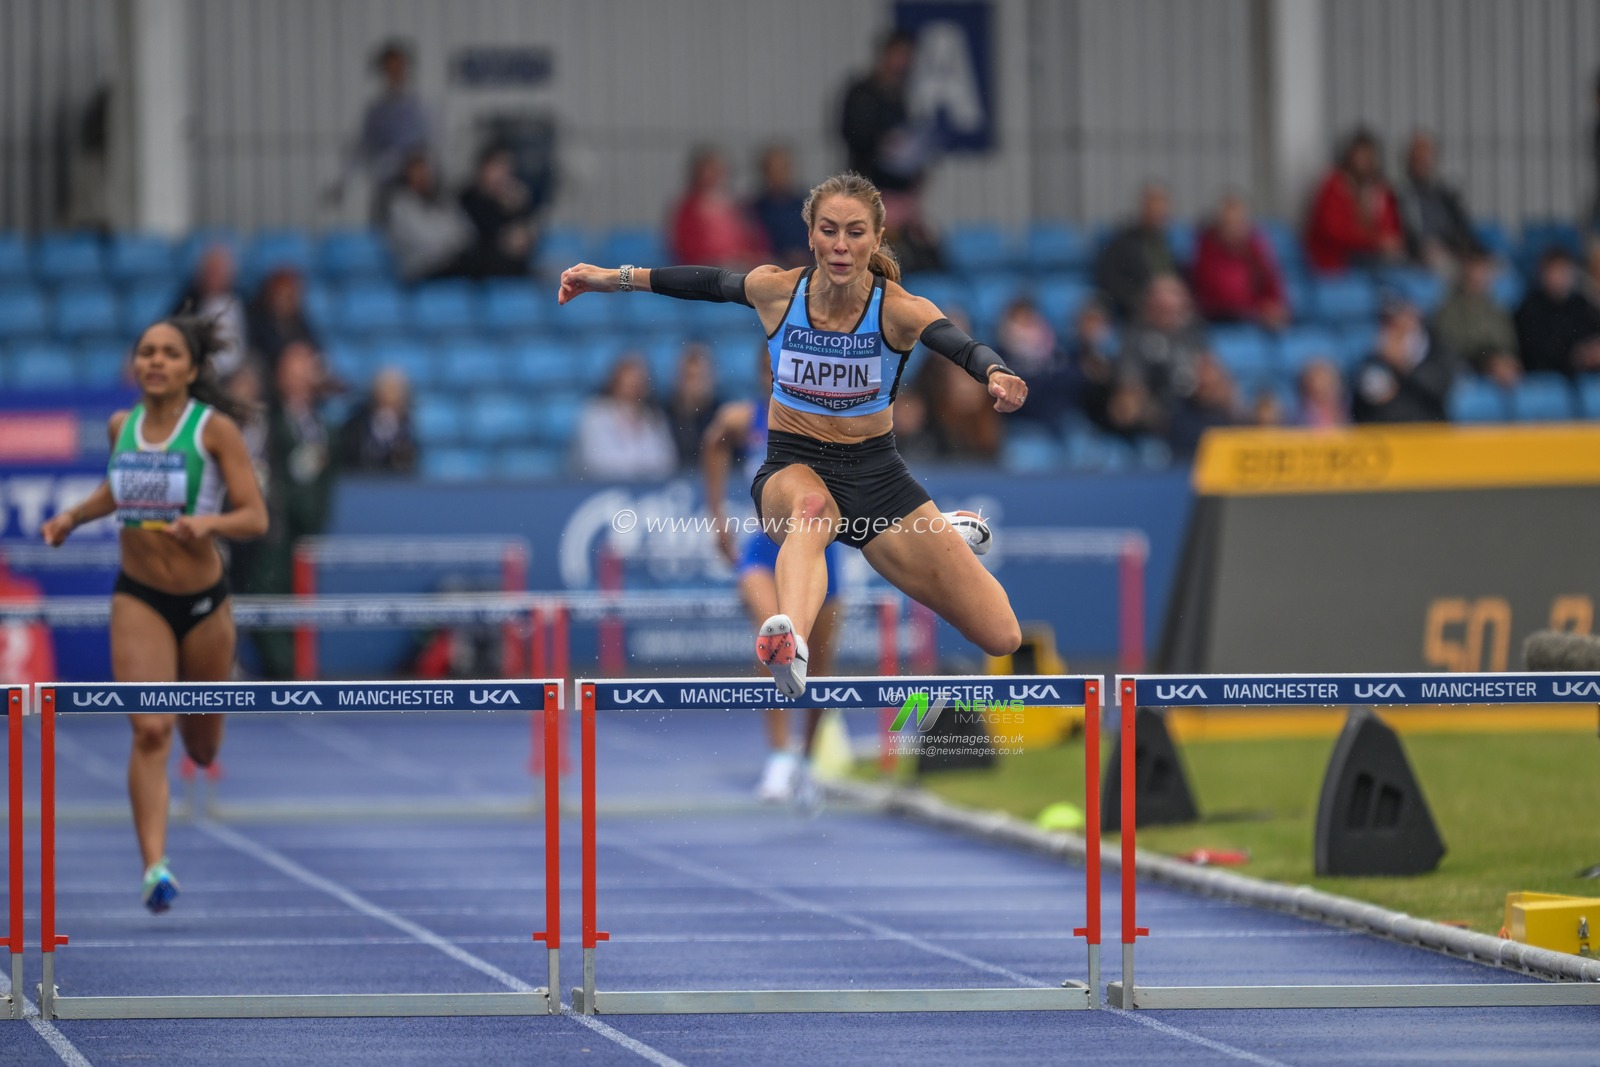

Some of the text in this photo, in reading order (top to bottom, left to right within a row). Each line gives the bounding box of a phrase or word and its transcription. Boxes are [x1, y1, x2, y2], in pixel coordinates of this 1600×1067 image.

[907, 20, 981, 132] A
[788, 329, 876, 357] Microplus
[788, 342, 804, 350] DATA
[805, 344, 843, 355] PROCESSING
[791, 358, 869, 388] TAPPIN
[73, 689, 520, 707] UKA MANCHESTER UKA MANCHESTER UKA
[613, 688, 664, 703] UKA
[811, 687, 862, 702] UKA
[878, 686, 994, 702] MANCHESTER
[1009, 685, 1061, 699] UKA
[1156, 685, 1208, 699] UKA
[1223, 683, 1339, 699] MANCHESTER
[1354, 683, 1406, 698] UKA
[1421, 682, 1537, 698] MANCHESTER
